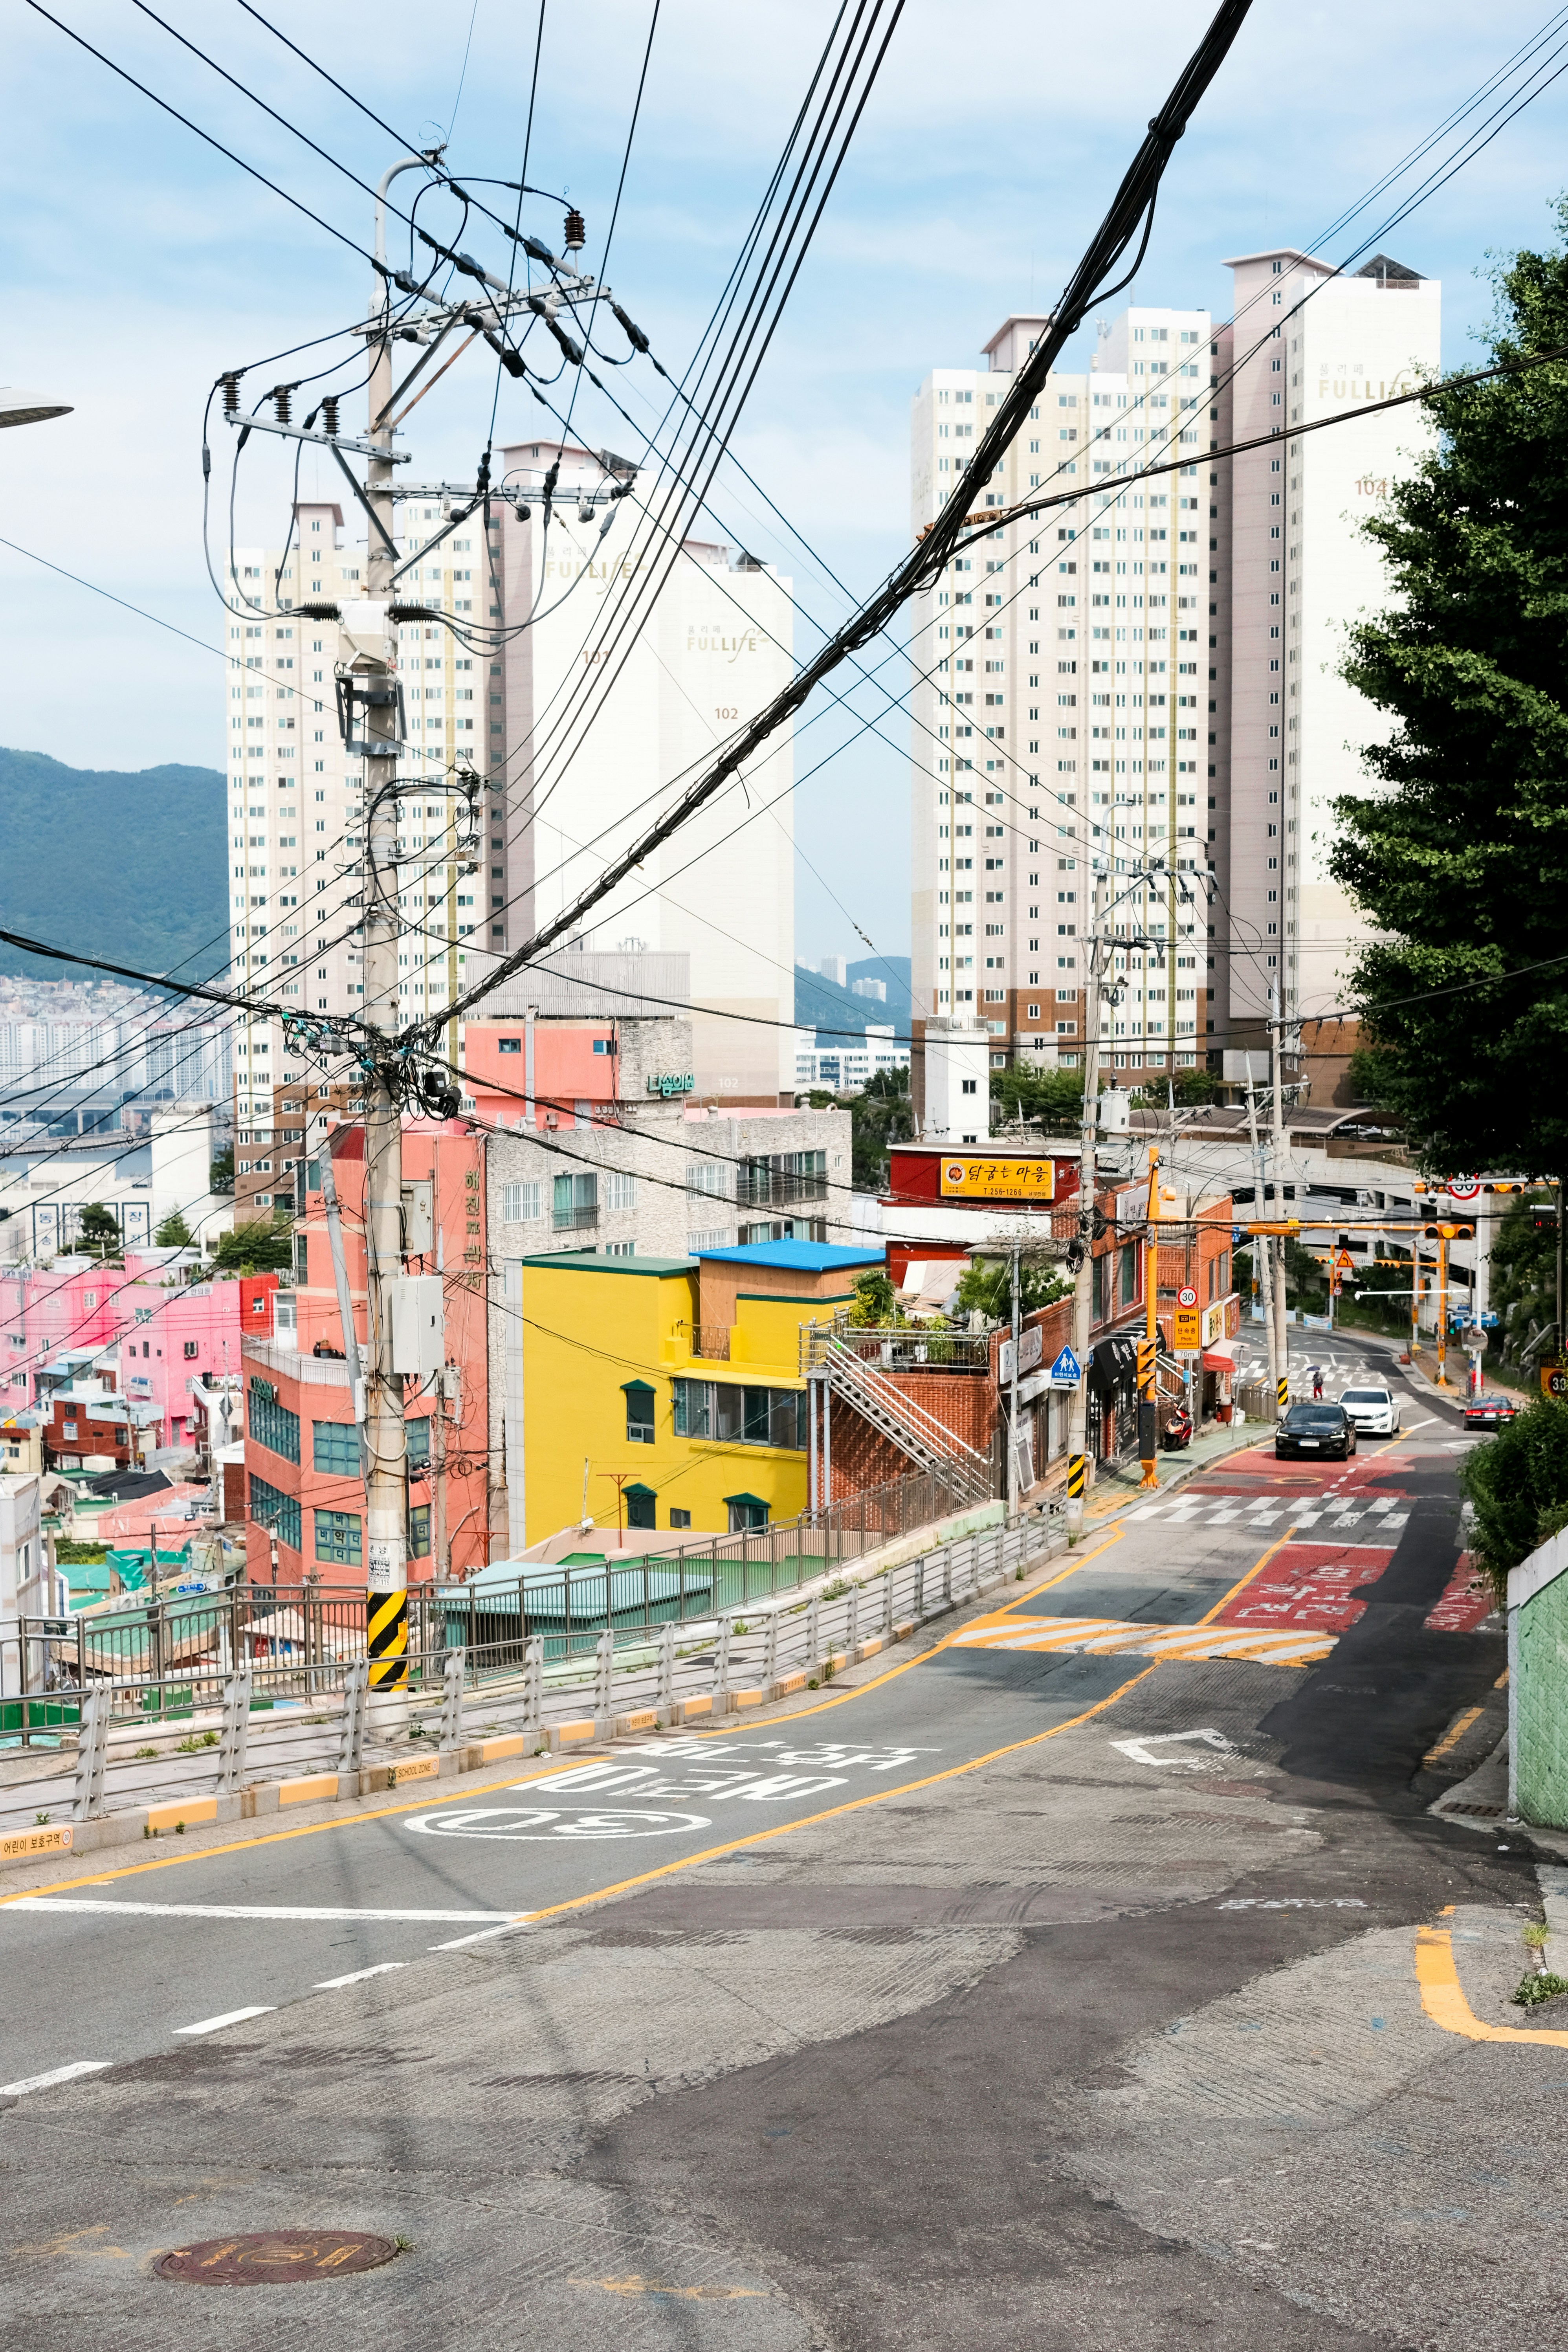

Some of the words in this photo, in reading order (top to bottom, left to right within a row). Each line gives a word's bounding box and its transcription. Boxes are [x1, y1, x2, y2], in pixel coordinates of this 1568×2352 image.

[1355, 479, 1387, 495] 104
[715, 708, 738, 719] 102
[718, 1078, 738, 1088] 102
[968, 1164, 1012, 1181] 닭굽는
[1016, 1166, 1048, 1183] 마을
[1182, 1293, 1193, 1301] 30
[398, 1766, 417, 1778] SCHOOL
[419, 1763, 431, 1773] ZONE
[437, 1810, 669, 1835] 30
[4, 1838, 27, 1854] 어린이
[31, 1833, 60, 1849] 보호구역
